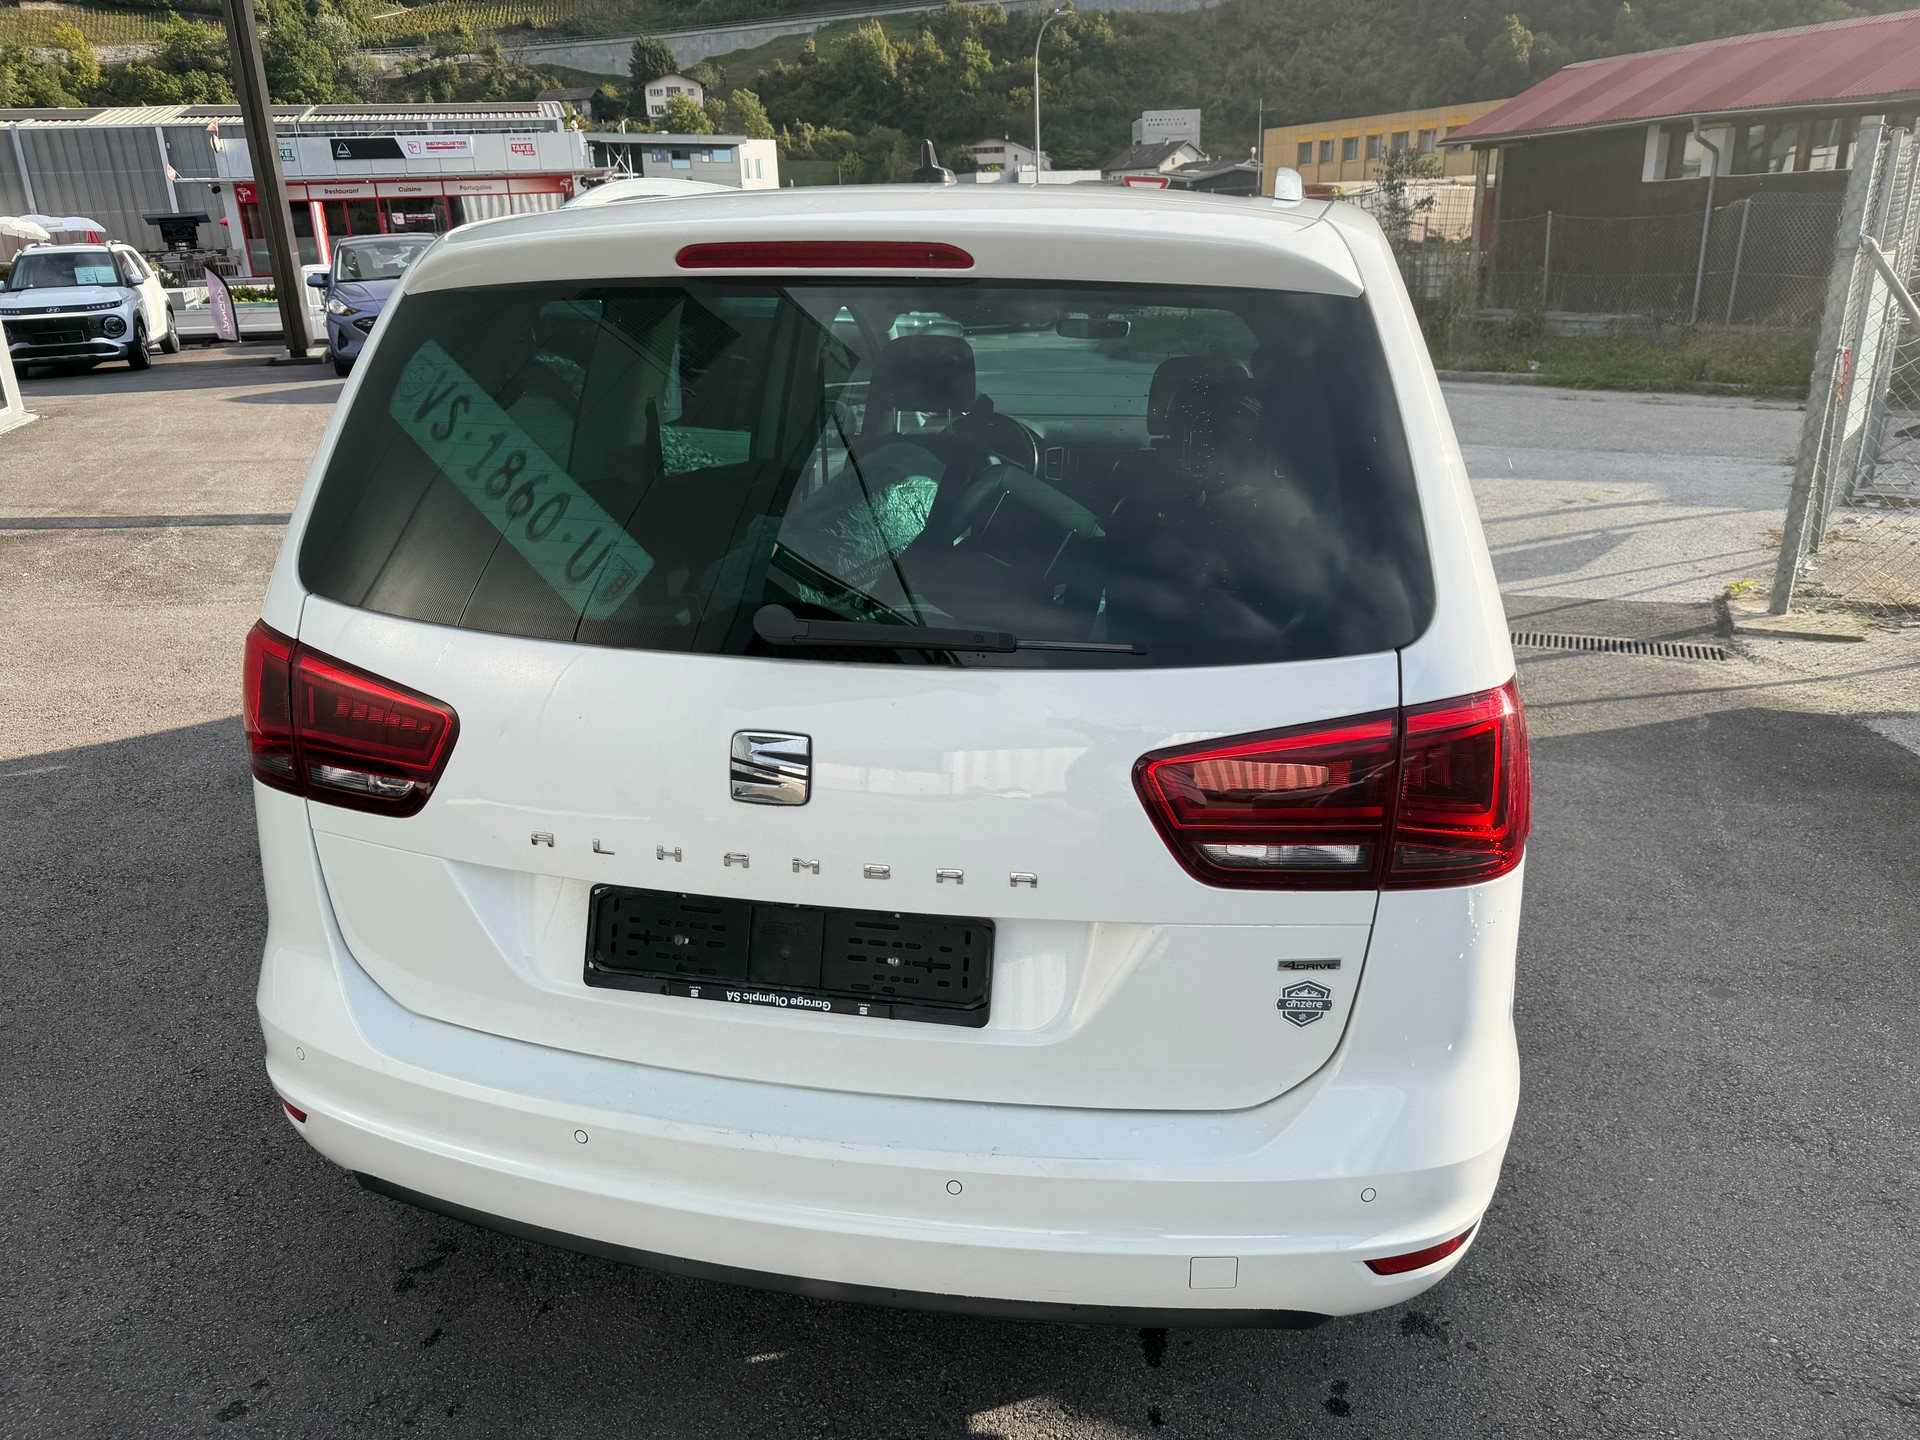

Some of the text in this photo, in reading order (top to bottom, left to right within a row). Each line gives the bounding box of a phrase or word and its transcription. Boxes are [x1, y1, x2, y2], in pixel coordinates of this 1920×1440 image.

[530, 830, 1039, 889] ALHAMBRA
[1281, 961, 1337, 970] 4DRIVE
[726, 990, 832, 1012] Garage Olympic SA
[1285, 1000, 1324, 1008] anzère
